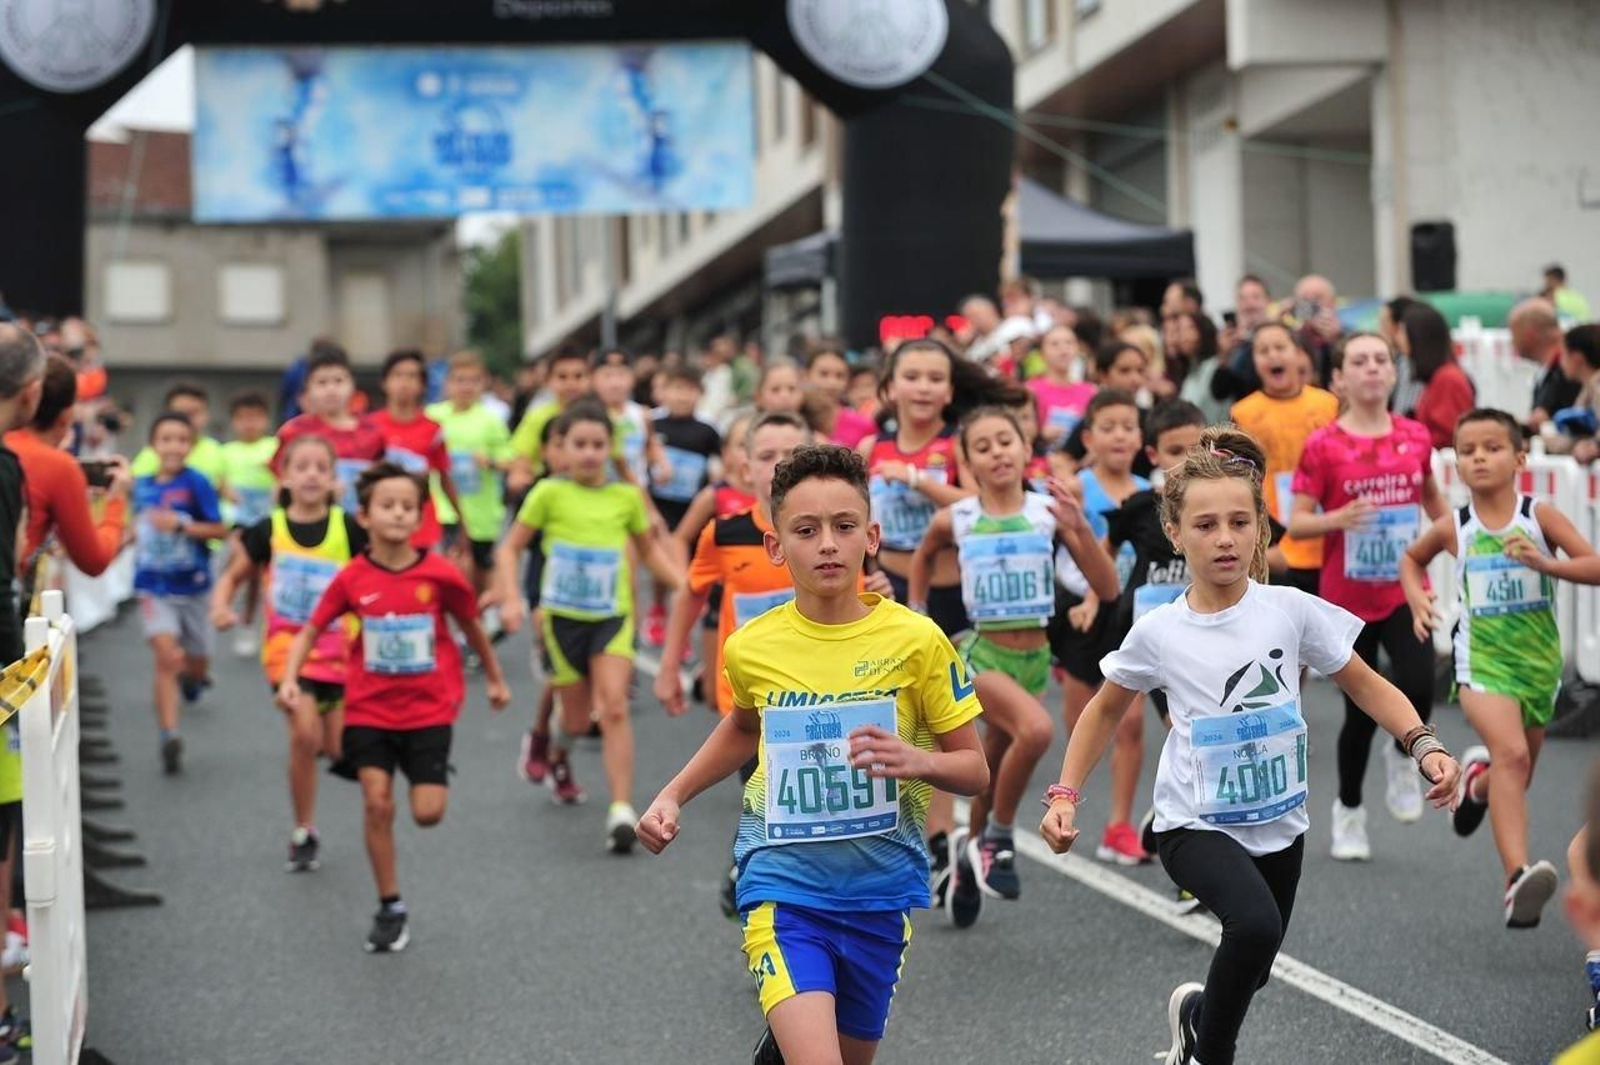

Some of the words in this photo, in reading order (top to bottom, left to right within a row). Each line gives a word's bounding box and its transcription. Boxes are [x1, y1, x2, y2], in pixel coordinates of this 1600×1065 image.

[1356, 538, 1408, 566] 404
[975, 571, 1037, 604] 4006
[777, 764, 874, 815] 4059
